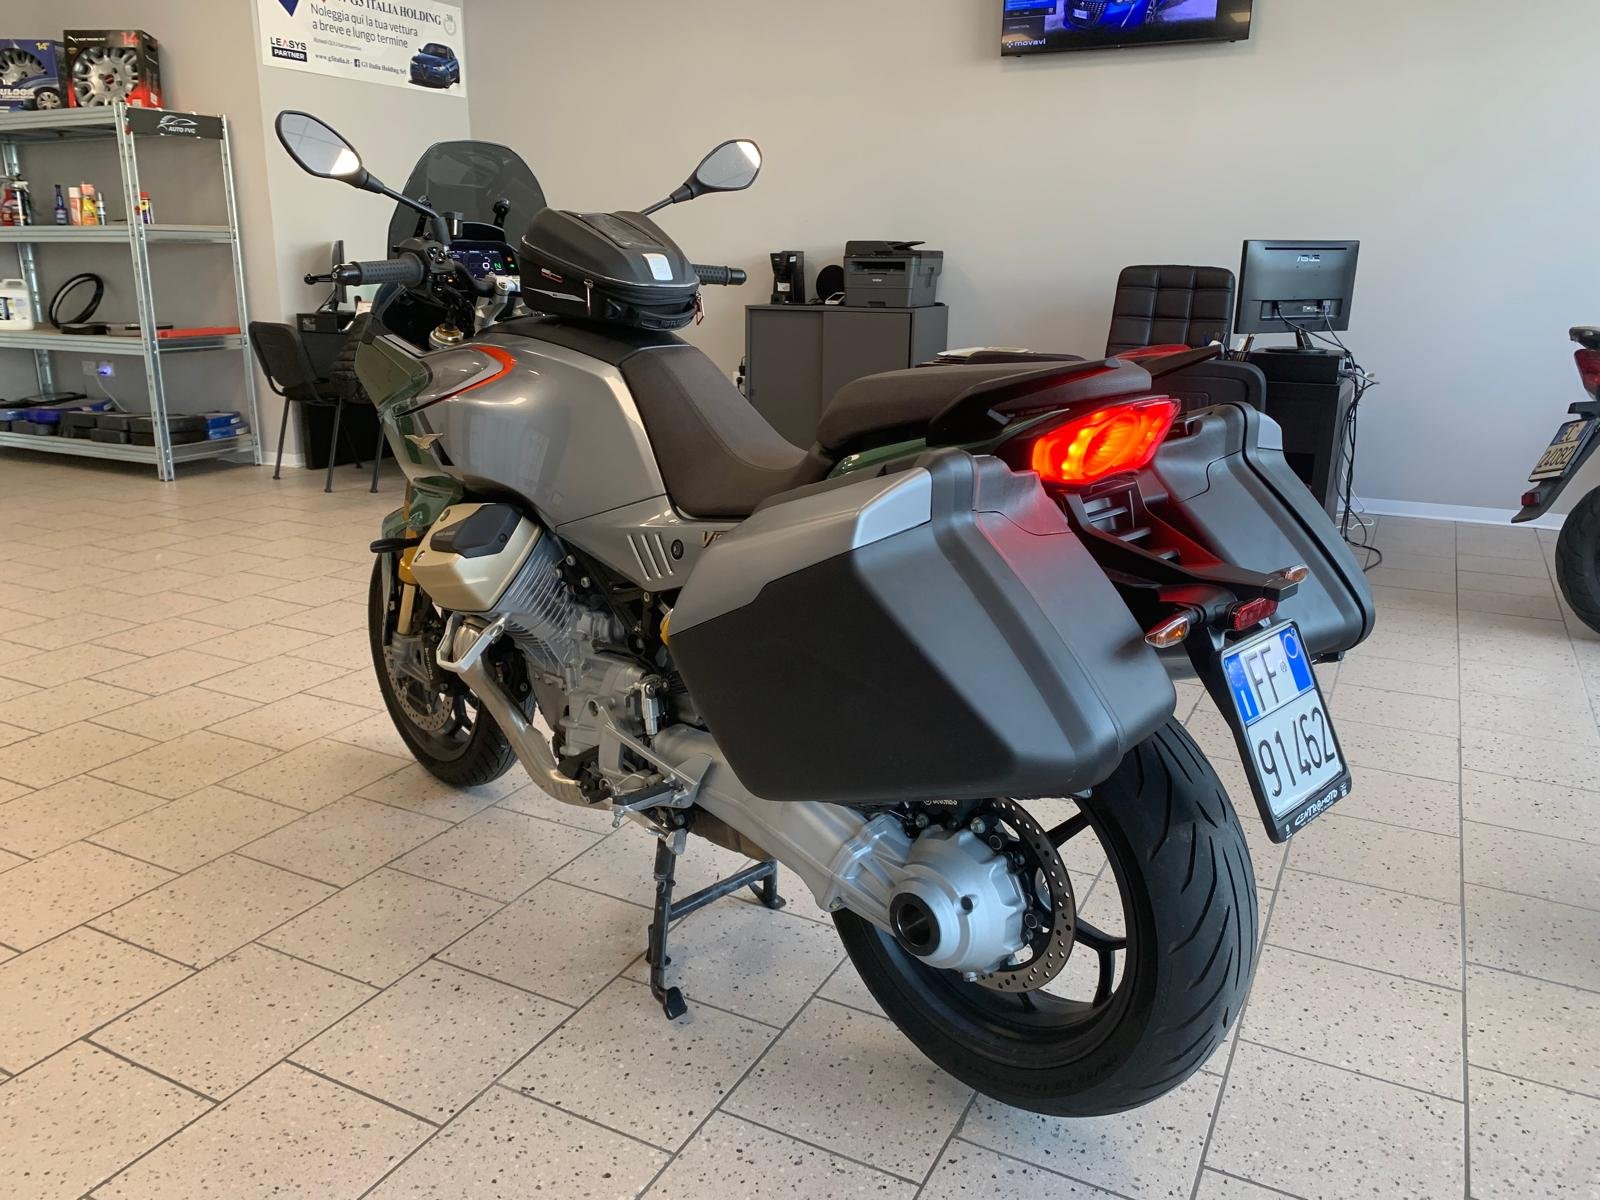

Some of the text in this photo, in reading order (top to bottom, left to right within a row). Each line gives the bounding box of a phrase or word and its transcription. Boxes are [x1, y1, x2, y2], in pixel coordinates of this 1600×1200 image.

[310, 3, 419, 37] Noleggia qui la tua vettura
[366, 0, 399, 16] ITALIA
[400, 8, 442, 26] HOLDING
[120, 31, 140, 46] 14
[270, 36, 307, 51] LEASYS
[312, 20, 318, 30] a
[319, 19, 345, 35] breve
[345, 27, 351, 36] e
[352, 26, 376, 43] lungo
[377, 33, 408, 48] termine
[1014, 37, 1046, 47] movavi
[273, 48, 305, 60] PARTNER
[1244, 643, 1279, 711] FF
[1258, 706, 1336, 798] 91462
